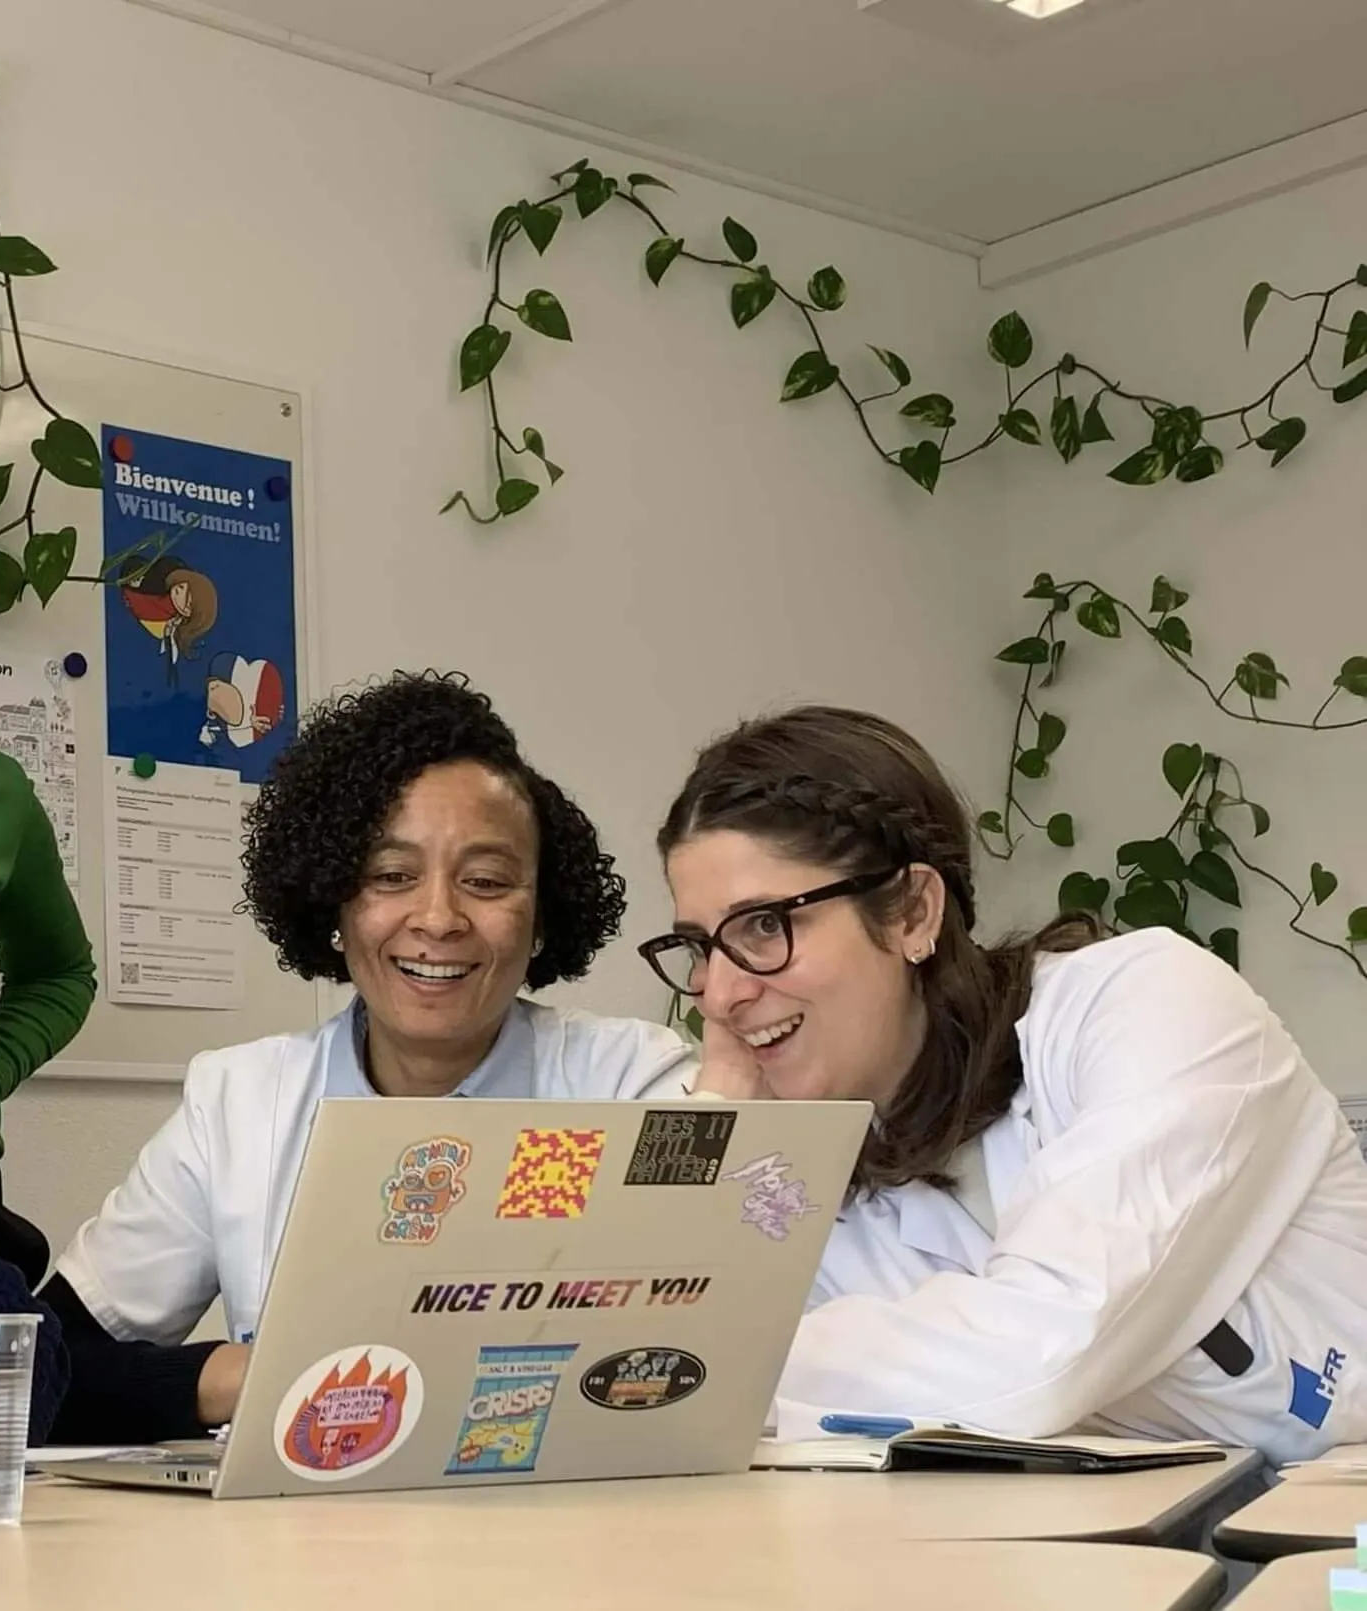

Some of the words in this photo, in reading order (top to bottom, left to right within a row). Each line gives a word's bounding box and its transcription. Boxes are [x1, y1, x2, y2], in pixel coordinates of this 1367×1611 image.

[114, 461, 243, 507] Bienvenue
[115, 491, 282, 543] Willkommen!
[410, 1283, 496, 1313] NICE
[499, 1281, 544, 1311] TO
[546, 1279, 643, 1310] MEET
[645, 1277, 712, 1306] YOU
